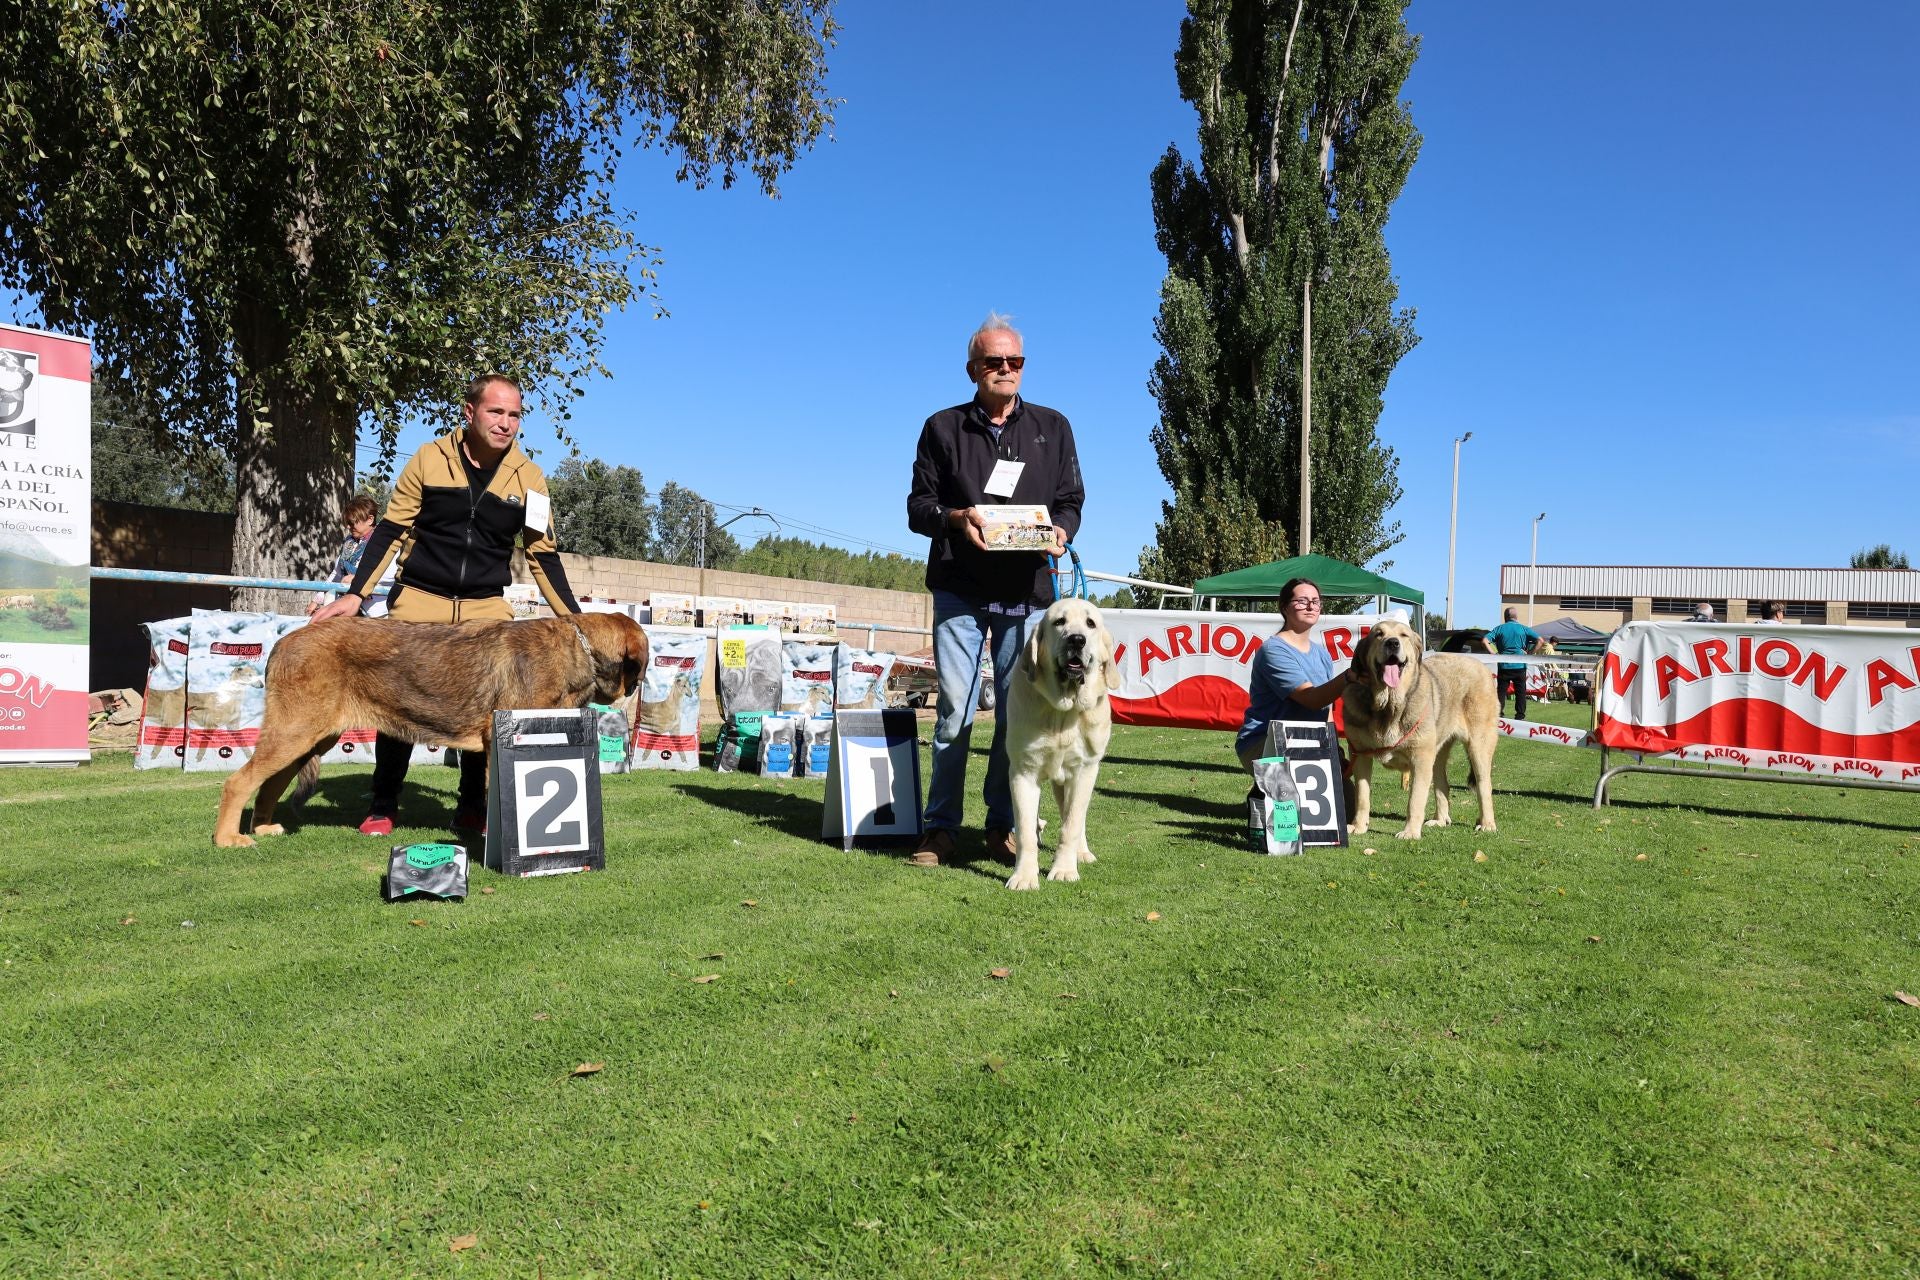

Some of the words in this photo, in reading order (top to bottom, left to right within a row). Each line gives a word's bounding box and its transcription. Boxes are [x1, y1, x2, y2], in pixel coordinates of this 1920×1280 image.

[14, 461, 36, 474] LA
[42, 464, 84, 480] CRÍA
[18, 480, 56, 494] DEL
[0, 498, 69, 514] SPAÑOL
[0, 520, 72, 535] nfo@ucme.es
[1655, 635, 1848, 702] ARION
[0, 667, 55, 708] ON
[1529, 725, 1572, 744] ARION
[1703, 745, 1751, 766] ARION
[1767, 753, 1815, 773] ARION
[1832, 759, 1883, 780] ARION
[525, 766, 582, 848] 2
[870, 757, 895, 826] 1
[1294, 764, 1332, 827] 3
